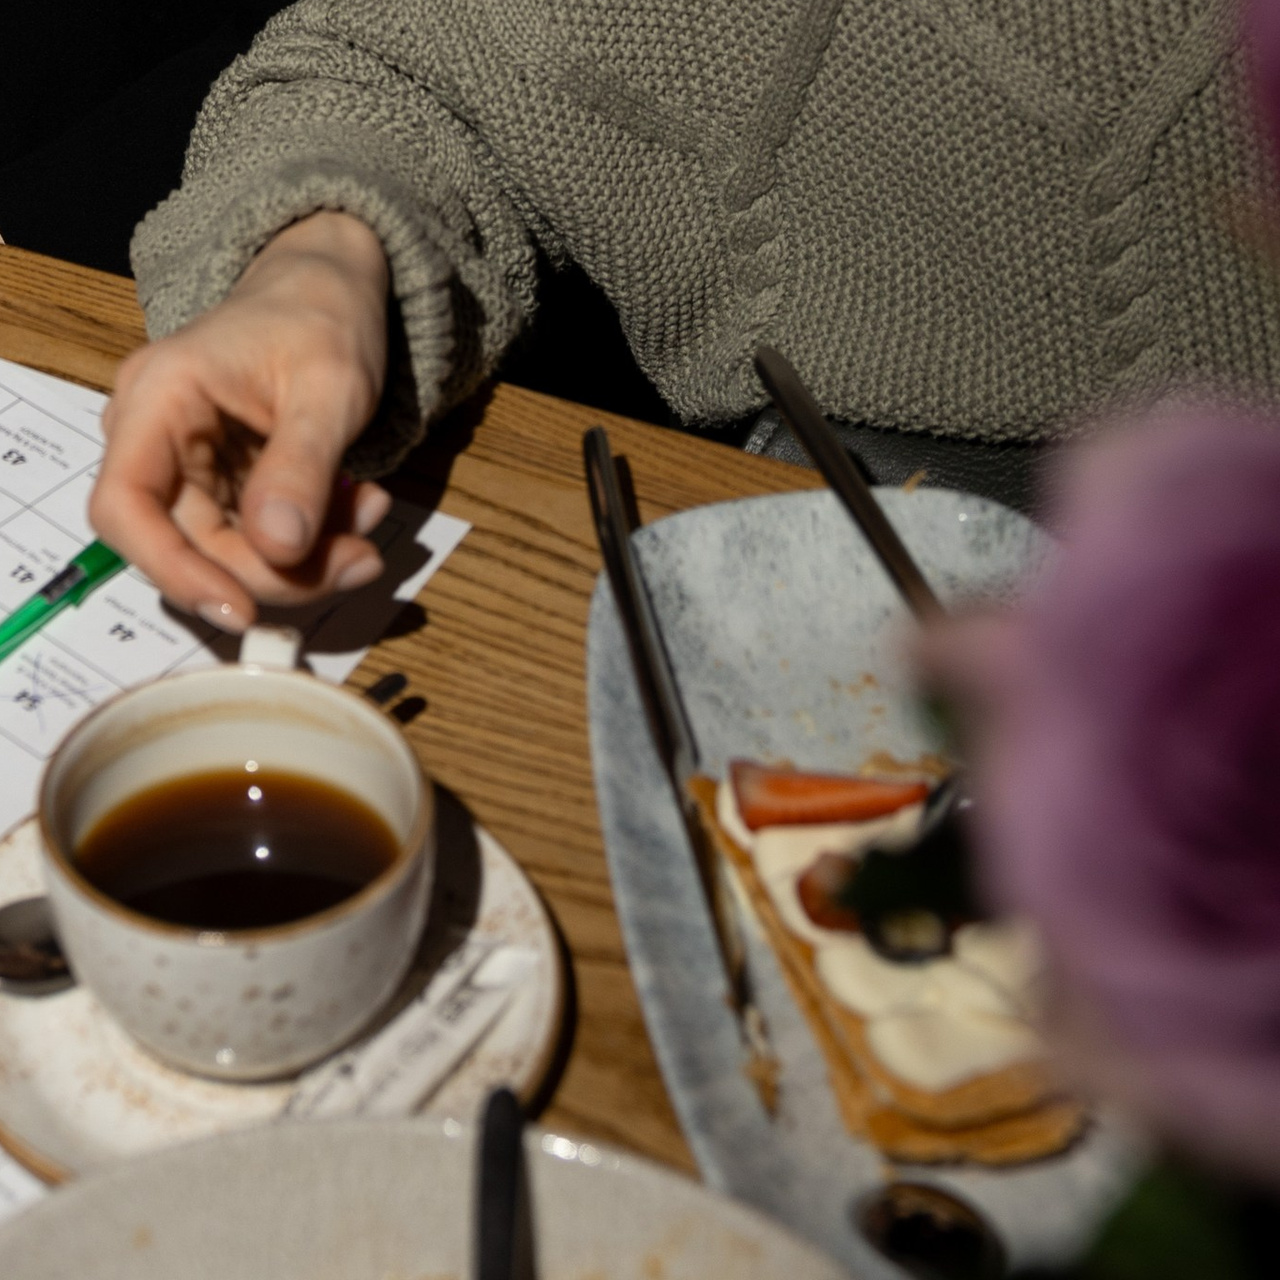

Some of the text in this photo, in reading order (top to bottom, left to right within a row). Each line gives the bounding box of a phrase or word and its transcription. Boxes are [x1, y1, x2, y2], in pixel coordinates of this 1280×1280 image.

[2, 450, 26, 465] 43
[11, 565, 34, 583] 41
[110, 623, 135, 642] 44
